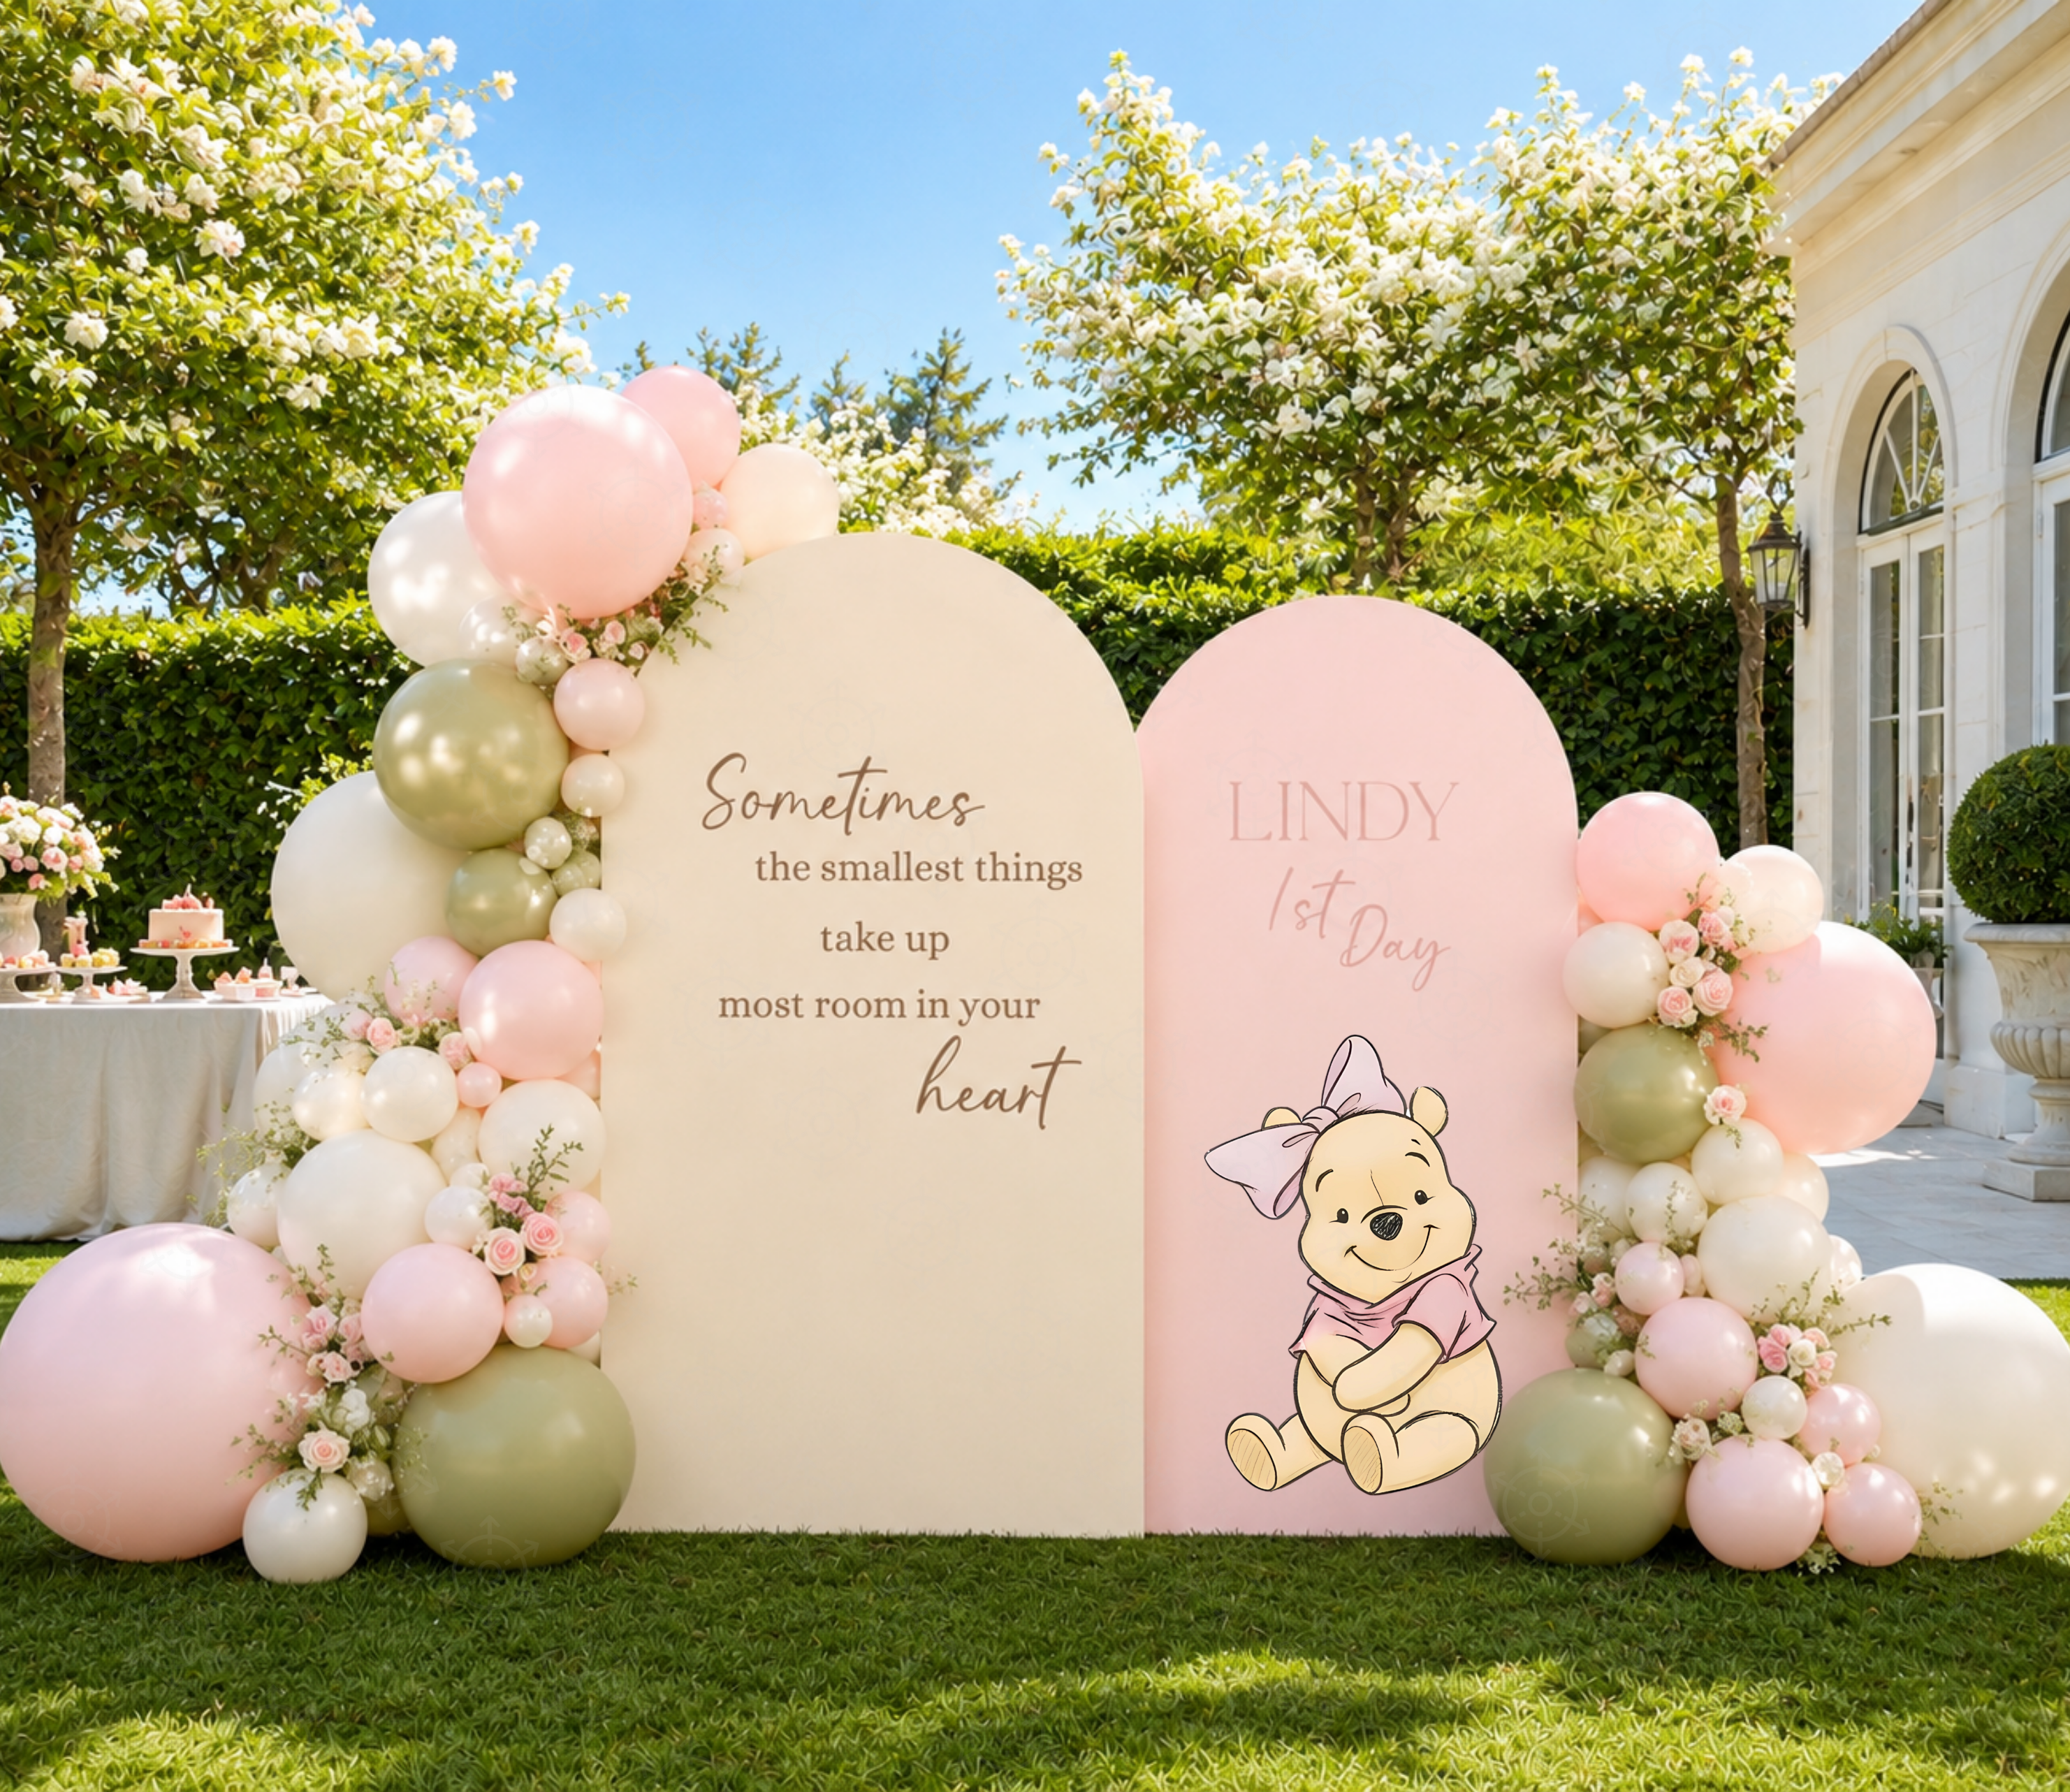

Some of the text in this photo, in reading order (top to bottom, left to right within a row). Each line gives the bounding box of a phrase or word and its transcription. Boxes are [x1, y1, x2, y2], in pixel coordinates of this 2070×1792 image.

[701, 752, 986, 837] Sometimes
[1229, 780, 1460, 841] LINDY
[755, 850, 1083, 891] the smallest things
[1269, 866, 1356, 940] 1st
[819, 920, 950, 961] take up
[1339, 903, 1451, 992] Day
[718, 988, 1041, 1028] most room in your
[915, 1034, 1083, 1131] heart
